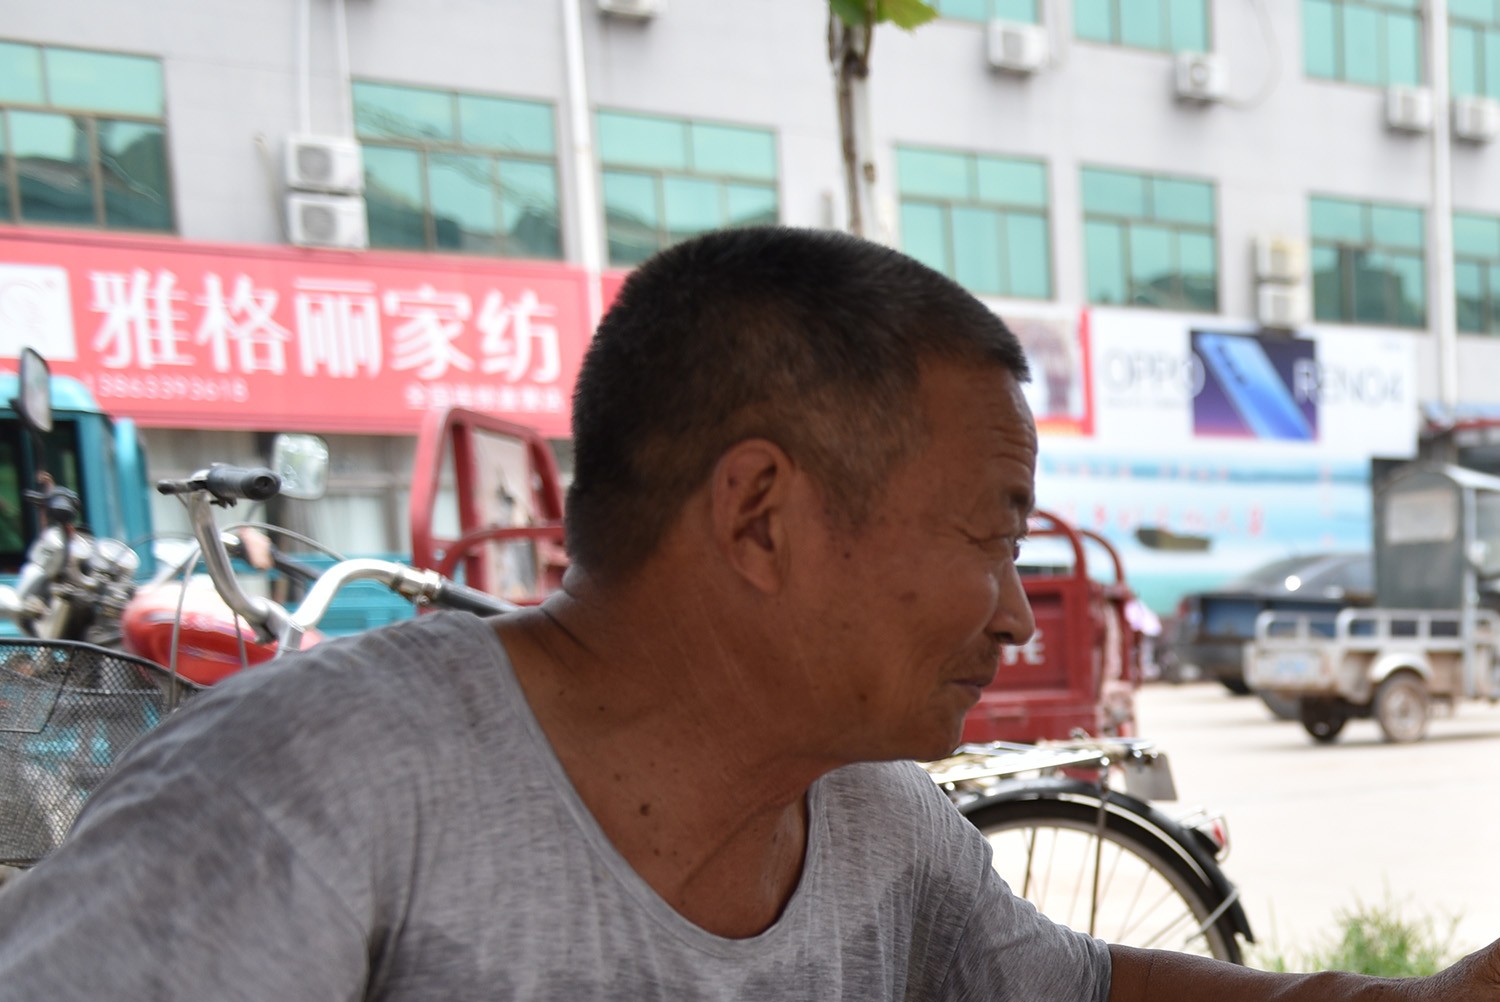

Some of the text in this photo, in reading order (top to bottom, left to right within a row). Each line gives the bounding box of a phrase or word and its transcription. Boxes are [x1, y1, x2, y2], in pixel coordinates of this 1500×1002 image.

[89, 266, 561, 383] 雅格丽家纺
